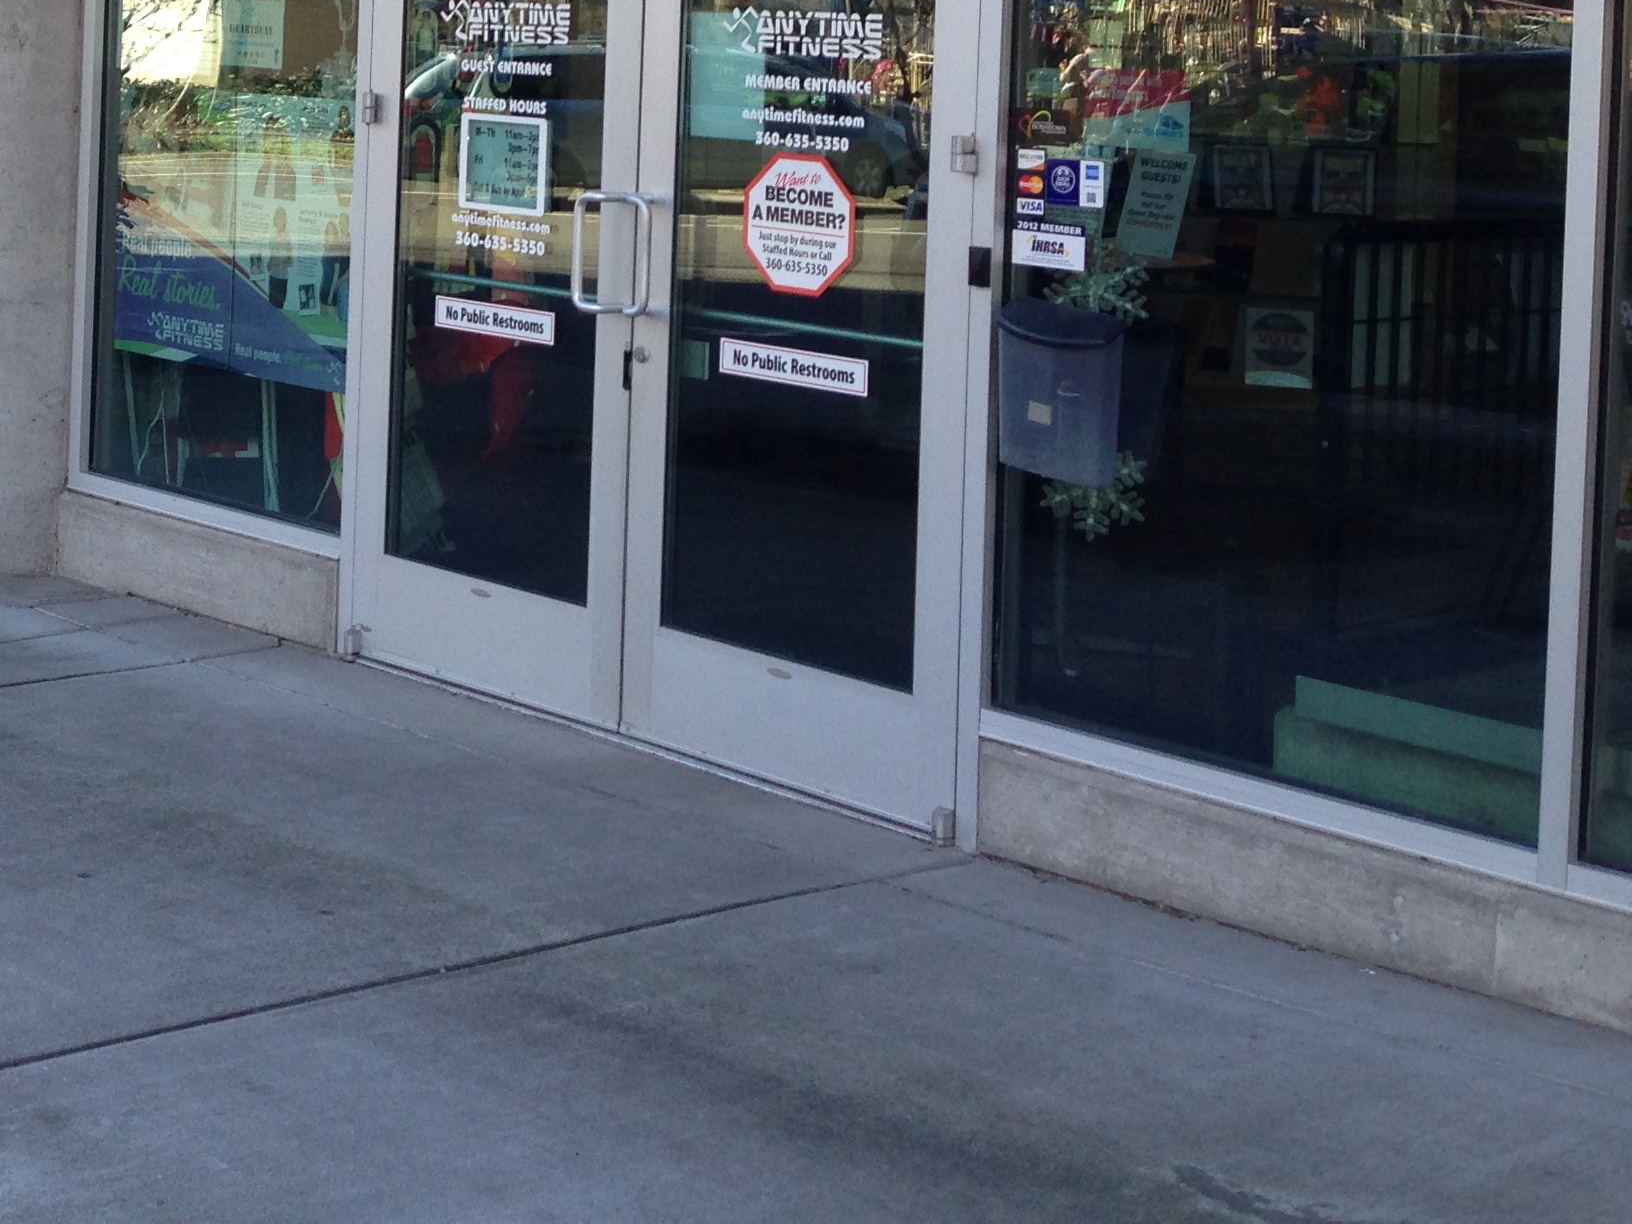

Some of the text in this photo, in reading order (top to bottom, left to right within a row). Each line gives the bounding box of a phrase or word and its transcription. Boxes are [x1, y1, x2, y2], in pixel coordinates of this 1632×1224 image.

[468, 1, 571, 26] ANYTIME
[756, 9, 883, 39] ANYTIME
[468, 24, 569, 45] FITNESS
[757, 35, 883, 60] FITNESS
[461, 59, 553, 76] GUEST ENTRANCE
[745, 74, 872, 95] MEMBER ENTRANCE
[462, 96, 548, 115] STAFFED HOURS
[741, 106, 865, 128] anytimefitness.com
[755, 131, 850, 152] 360-635-5350
[1141, 157, 1189, 172] WELCOME
[774, 170, 822, 189] Want to
[1141, 171, 1182, 185] GUESTS!
[765, 185, 834, 208] BECOME
[1020, 200, 1043, 212] VISA
[451, 212, 551, 235] anytimefitness.com
[752, 204, 846, 230] A MEMBER?
[1017, 220, 1082, 235] 2012 MEMBER
[455, 231, 546, 256] 360-635-5350
[758, 231, 836, 249] Just stop by during our
[1031, 236, 1065, 255] IHRSA
[762, 243, 832, 261] Staffed Hours or Call
[766, 257, 828, 277] 360-635-5350
[118, 254, 222, 310] Real stories.
[162, 315, 224, 339] ANYTIME
[446, 305, 544, 335] No Public Restrooms
[162, 329, 224, 352] FITNESS
[235, 342, 252, 357] Real
[1257, 332, 1303, 346] VOTE
[733, 348, 855, 385] No Public Restrooms
